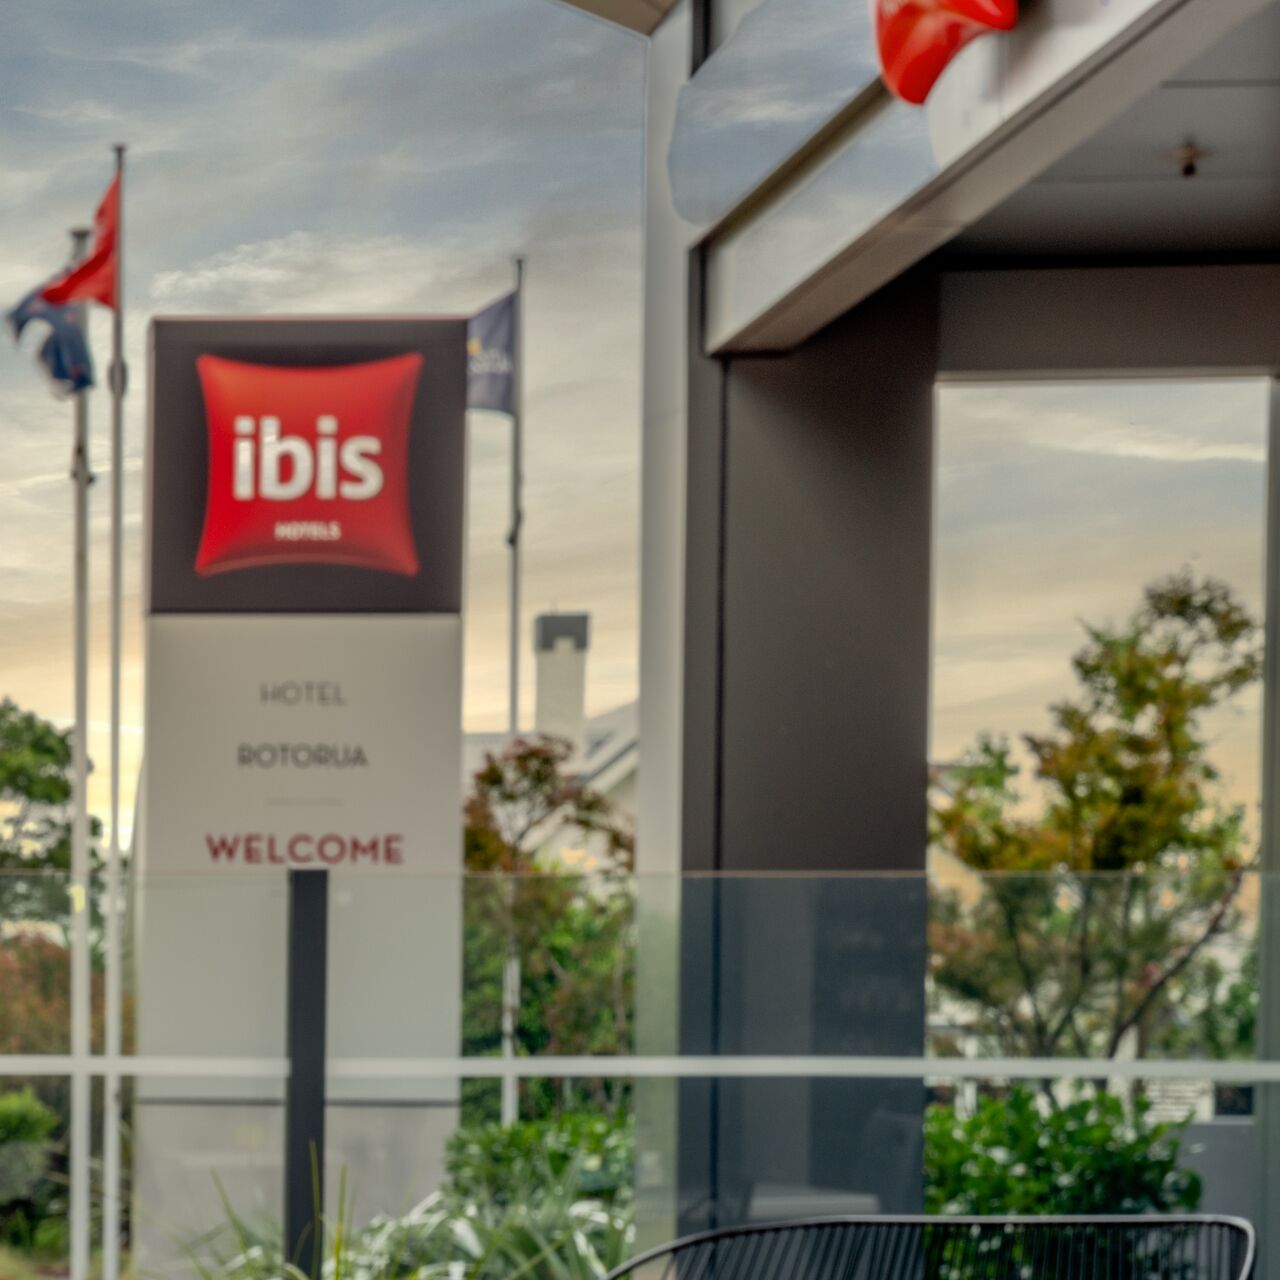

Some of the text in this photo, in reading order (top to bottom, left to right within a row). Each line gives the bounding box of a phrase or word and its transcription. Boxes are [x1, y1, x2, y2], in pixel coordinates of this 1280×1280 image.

[233, 415, 384, 501] ibis
[274, 520, 342, 542] HOTELS
[260, 682, 348, 707] HOTEL
[237, 743, 369, 771] ROTORUA
[206, 834, 405, 866] WELCOME
